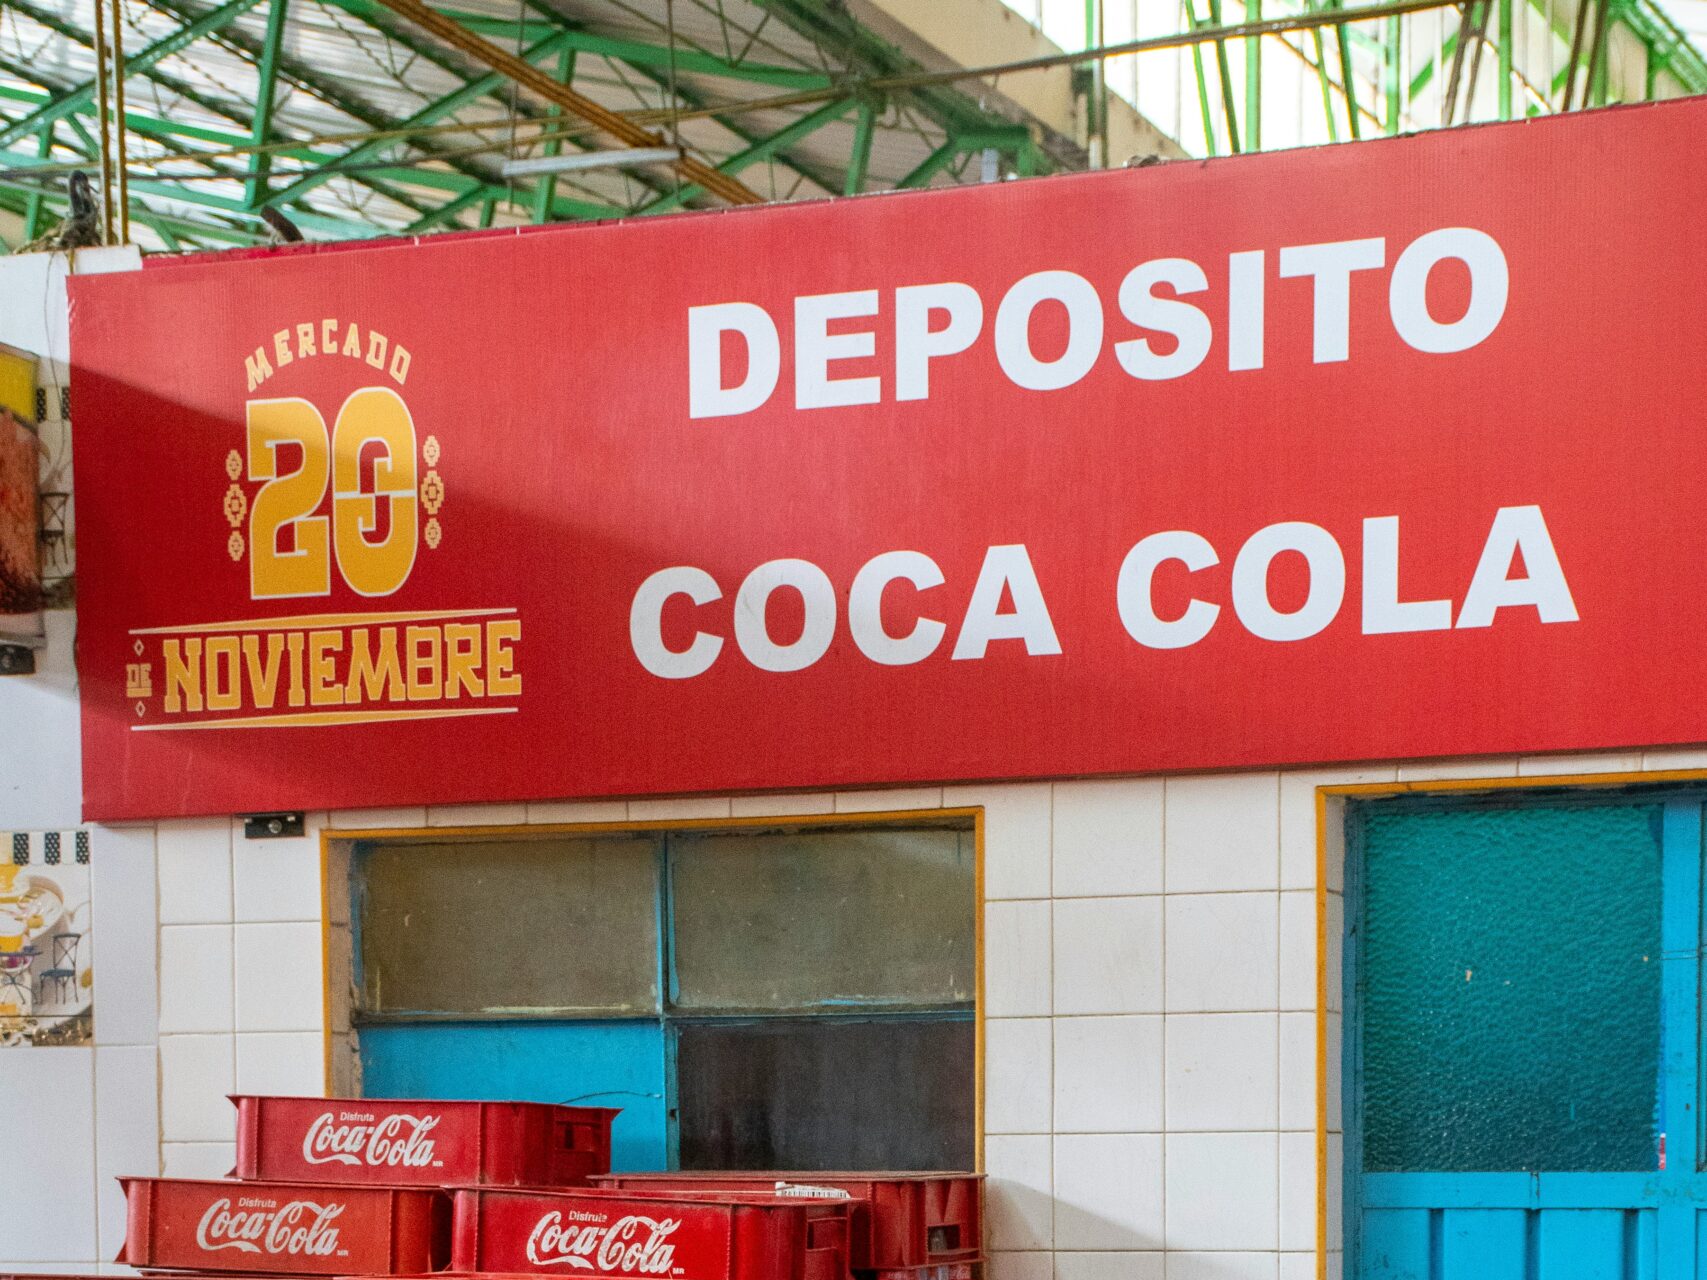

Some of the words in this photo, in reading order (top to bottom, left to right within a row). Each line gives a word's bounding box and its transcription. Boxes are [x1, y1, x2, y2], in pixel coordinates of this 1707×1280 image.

[245, 319, 411, 392] MERCADO
[688, 227, 1509, 419] DEPOSITO
[246, 386, 418, 599] 20
[629, 544, 1062, 679] COCA
[1117, 504, 1580, 649] COLA
[127, 663, 152, 690] DE
[163, 620, 521, 712] NOVIEMBRE
[303, 1113, 441, 1168] Coca-Cola
[340, 1112, 374, 1122] Disfruta
[196, 1198, 346, 1256] Coca-Cola
[238, 1197, 277, 1208] Disfruta
[526, 1211, 682, 1274] Coca-Cola
